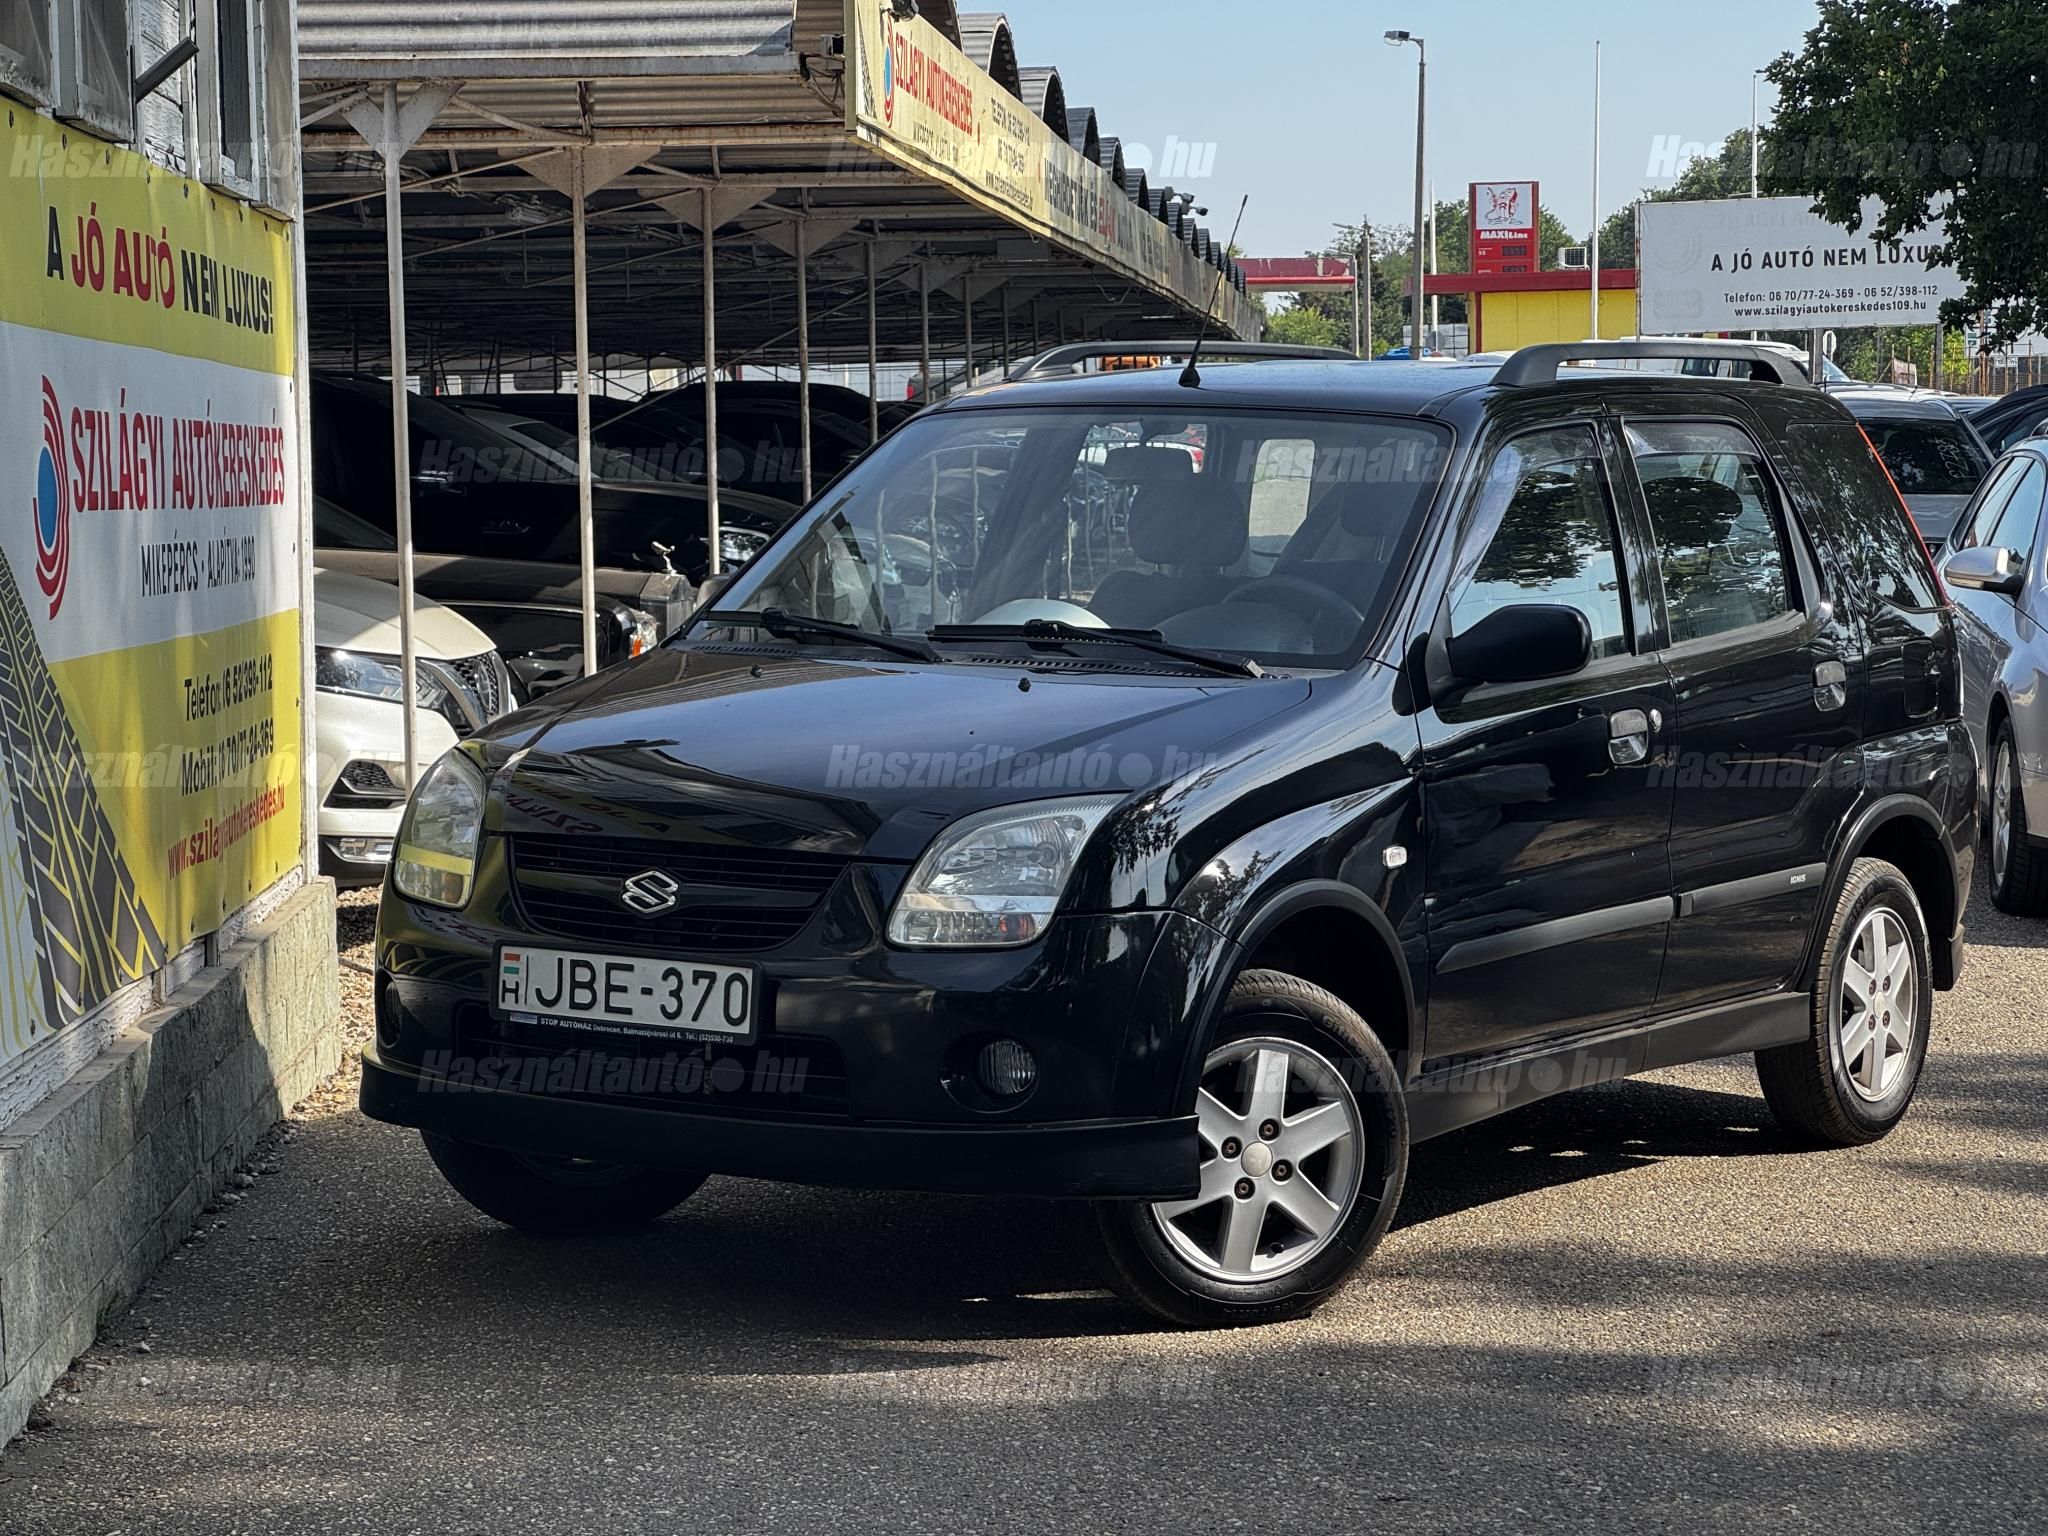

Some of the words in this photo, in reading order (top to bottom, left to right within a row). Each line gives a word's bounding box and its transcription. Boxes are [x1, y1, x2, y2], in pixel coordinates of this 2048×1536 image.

[47, 205, 65, 281] A
[71, 201, 105, 292] JÓ
[113, 226, 176, 309] AUTÓ
[181, 249, 220, 320] NEM
[222, 264, 274, 335] LUXUS!
[1711, 254, 1724, 273] A
[1731, 247, 1752, 273] JÓ
[1761, 245, 1814, 270] AUTÓ
[1823, 247, 1867, 267] NEM
[1723, 290, 1766, 304] Telefon:
[1768, 290, 1783, 303] 06
[1784, 286, 1855, 303] 70/77-24-369
[1863, 286, 1878, 299] 06
[1880, 283, 1939, 299] 52/398-112
[1734, 299, 1927, 317] www.szilagyiautokereskedes109.hu
[70, 387, 166, 514] SZILÁGYI
[171, 398, 285, 511] AUTÓKERESKEDÉS
[141, 528, 199, 598] MIKEPÉRCS
[207, 525, 241, 589] ALAPÍTVA:
[241, 535, 256, 582] 1990
[181, 744, 218, 797] Mobil:
[501, 979, 520, 1004] H
[534, 956, 749, 1027] JBE-370
[540, 1016, 559, 1027] STOP
[559, 1018, 593, 1031] AUTÓHÁZ
